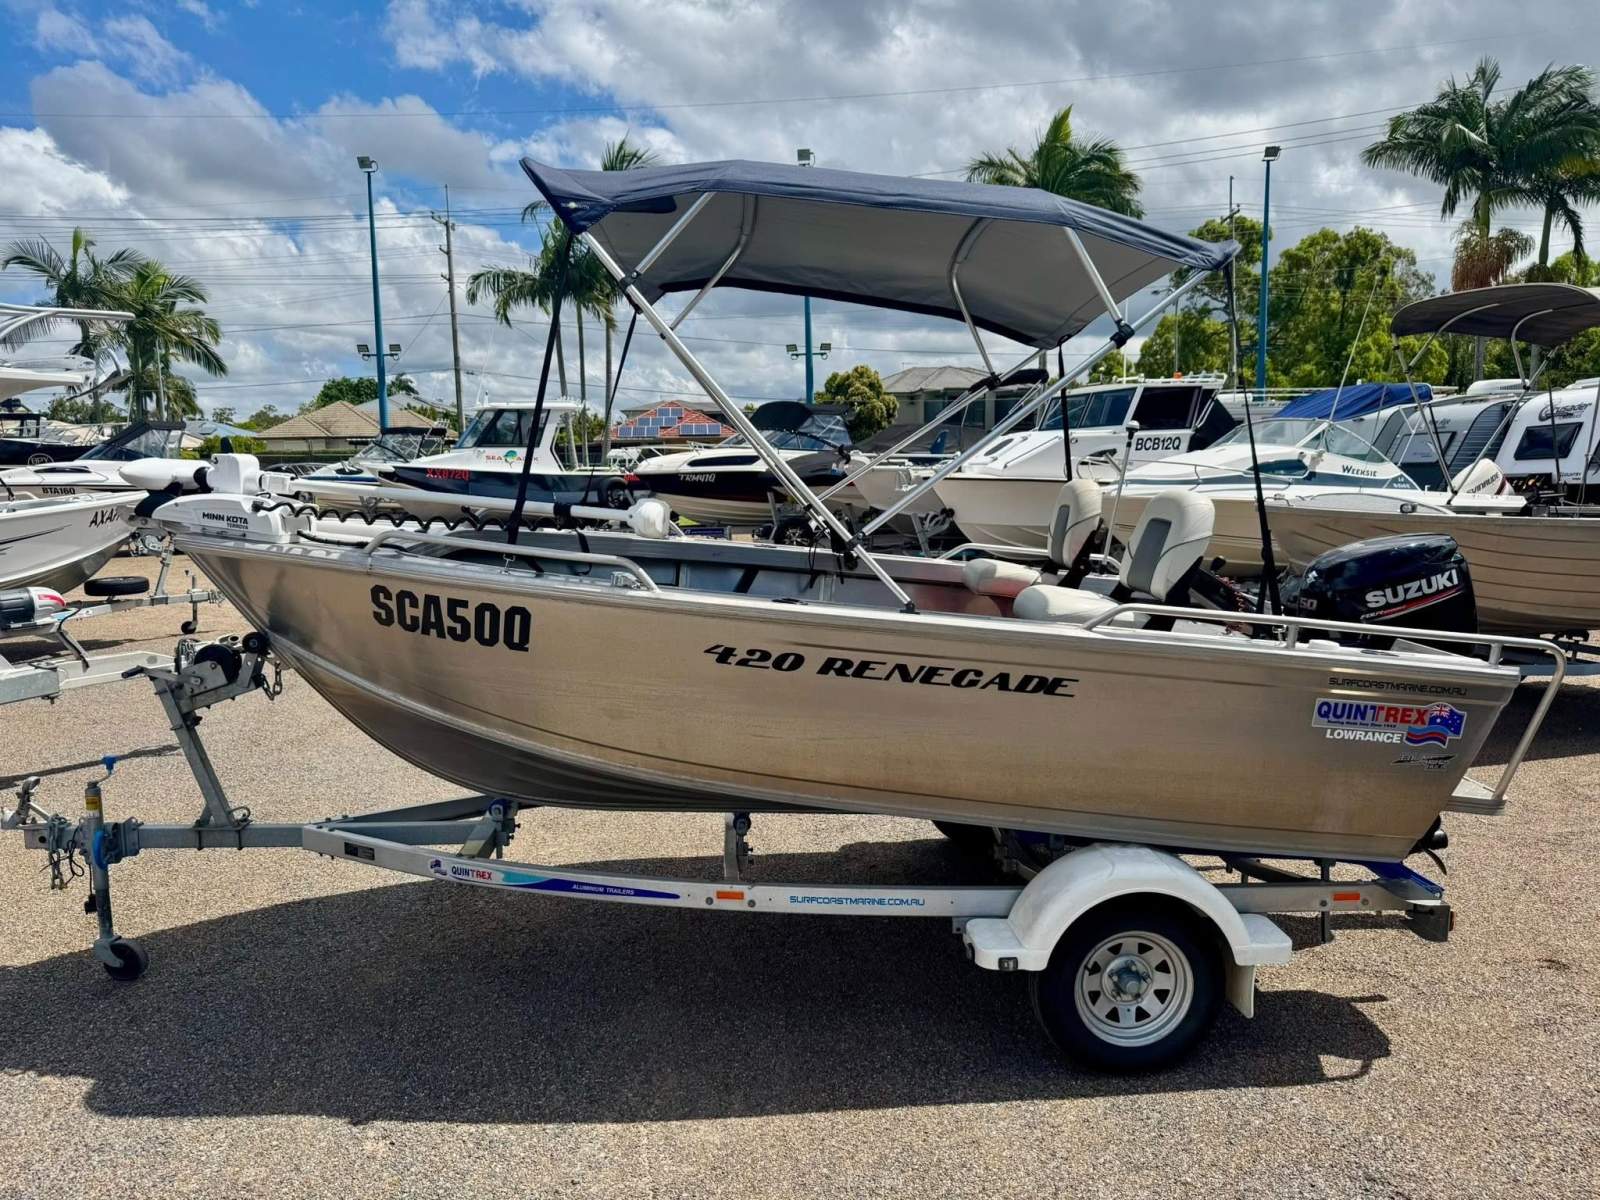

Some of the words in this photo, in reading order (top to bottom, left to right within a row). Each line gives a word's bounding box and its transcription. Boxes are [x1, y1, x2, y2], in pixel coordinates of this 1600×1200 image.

[1135, 436, 1181, 451] BCB12Q
[202, 512, 225, 522] MINN
[226, 515, 248, 525] KOTA
[1365, 569, 1459, 608] SUZUKI
[370, 584, 532, 652] SCA50Q
[703, 644, 806, 672] 420
[816, 657, 1080, 697] RENEGADE
[1328, 677, 1468, 696] SURFCOASTMARINE.COM.AU
[1317, 701, 1428, 726] QUINTREX
[1326, 728, 1402, 744] LOWRANCE
[451, 866, 492, 880] QUINTREX
[606, 887, 635, 896] TRAILERS
[789, 895, 926, 906] SURFCOASTMARINE.COM.AU
